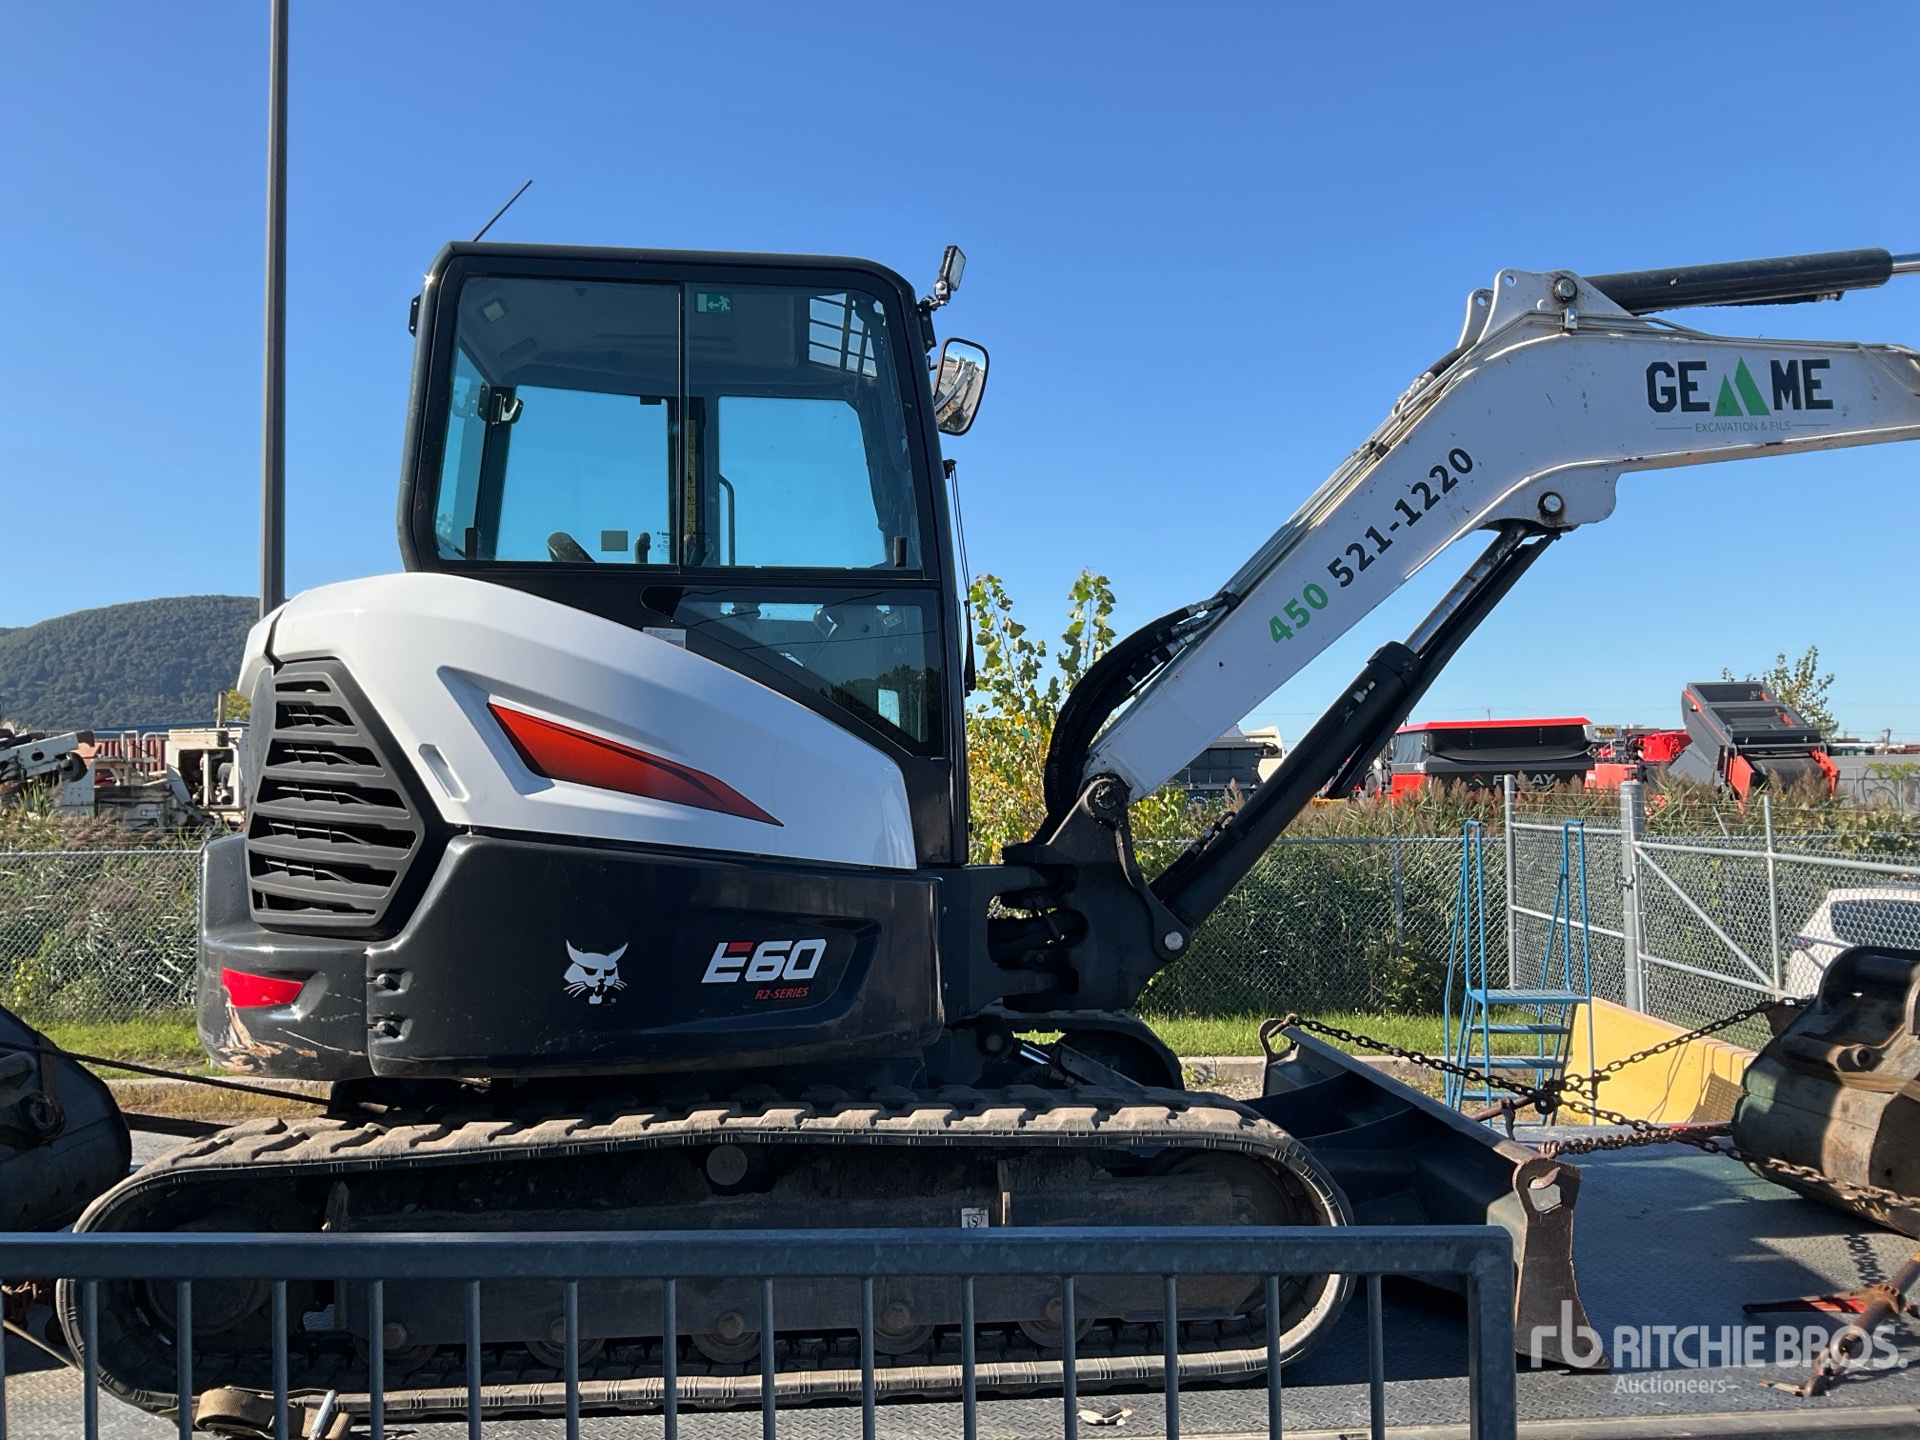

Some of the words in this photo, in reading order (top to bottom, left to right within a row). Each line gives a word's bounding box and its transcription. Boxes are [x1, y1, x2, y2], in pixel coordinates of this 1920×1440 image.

[1695, 421, 1758, 433] EXCAVATION
[1760, 421, 1768, 432] &
[1770, 420, 1792, 431] FILS
[1268, 583, 1329, 644] 450
[1327, 448, 1473, 588] 521-1220
[701, 938, 828, 984] E60
[755, 986, 810, 1000] R2-SERIES
